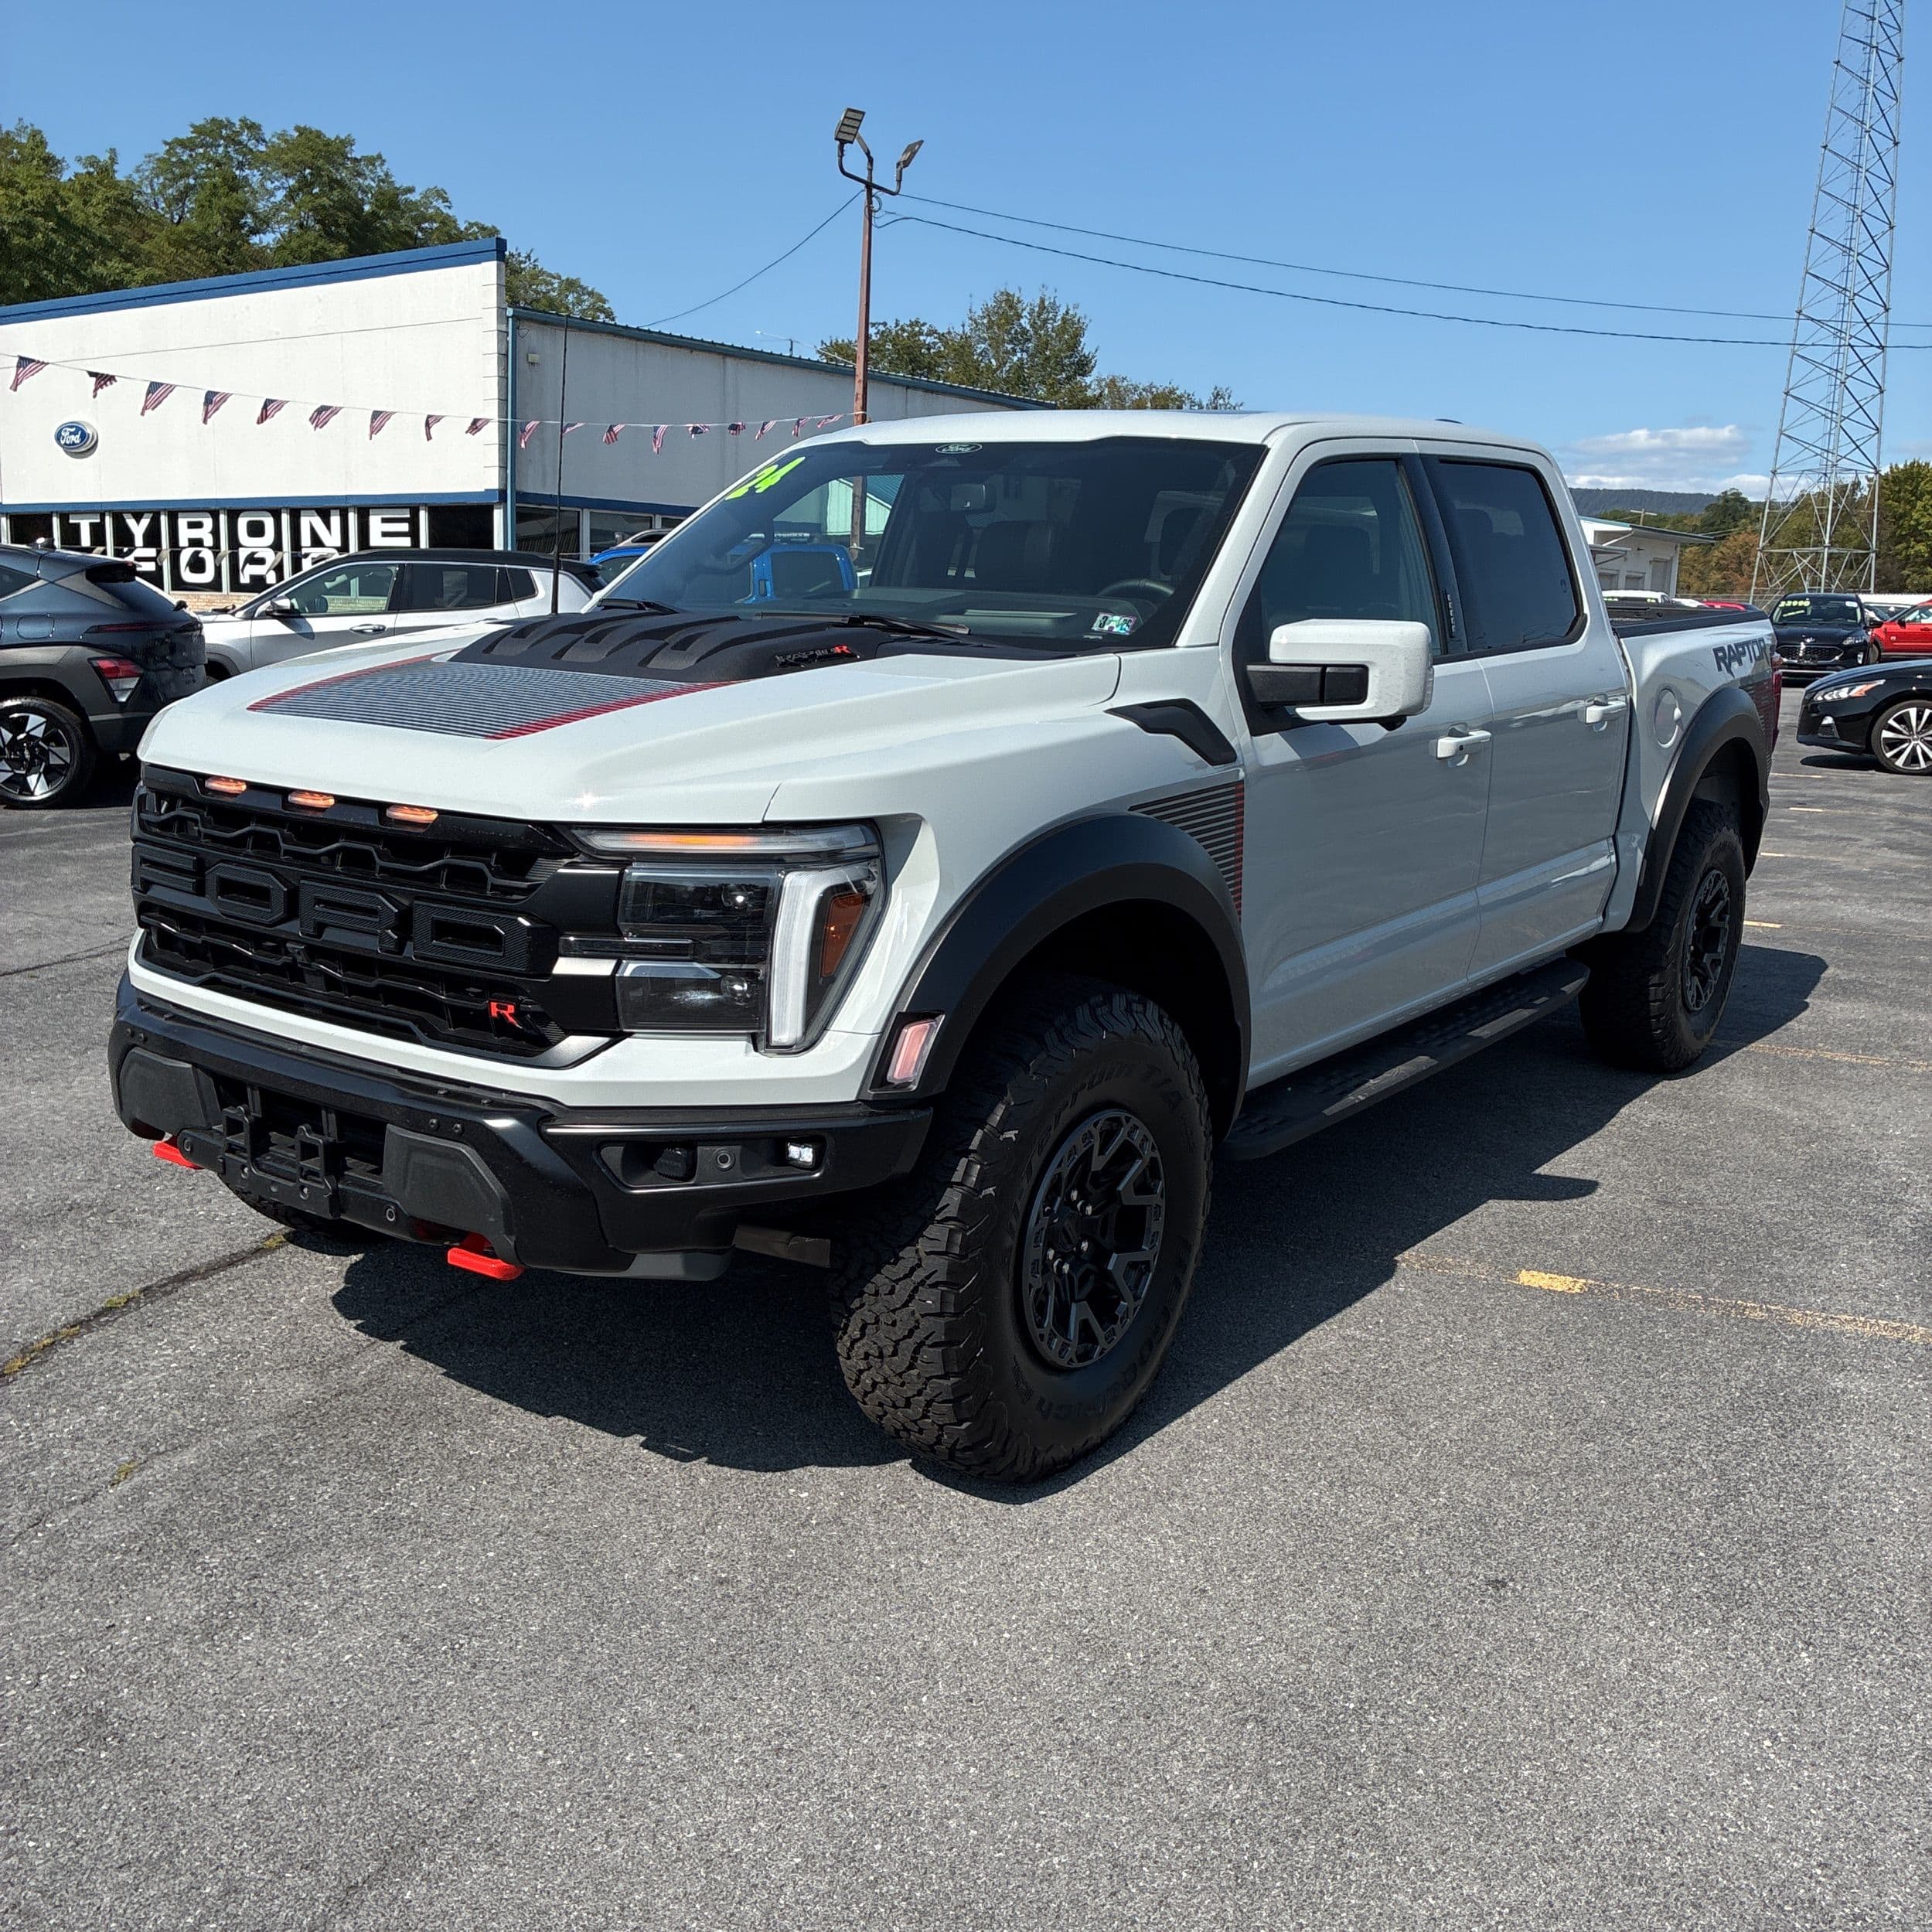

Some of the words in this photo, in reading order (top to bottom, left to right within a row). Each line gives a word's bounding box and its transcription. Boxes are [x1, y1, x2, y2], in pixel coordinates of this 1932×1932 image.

[60, 427, 81, 445] Ford
[69, 508, 412, 547] TYRONE
[1712, 637, 1772, 679] RAPTOR
[133, 848, 533, 972] FORD
[490, 1001, 523, 1029] R
